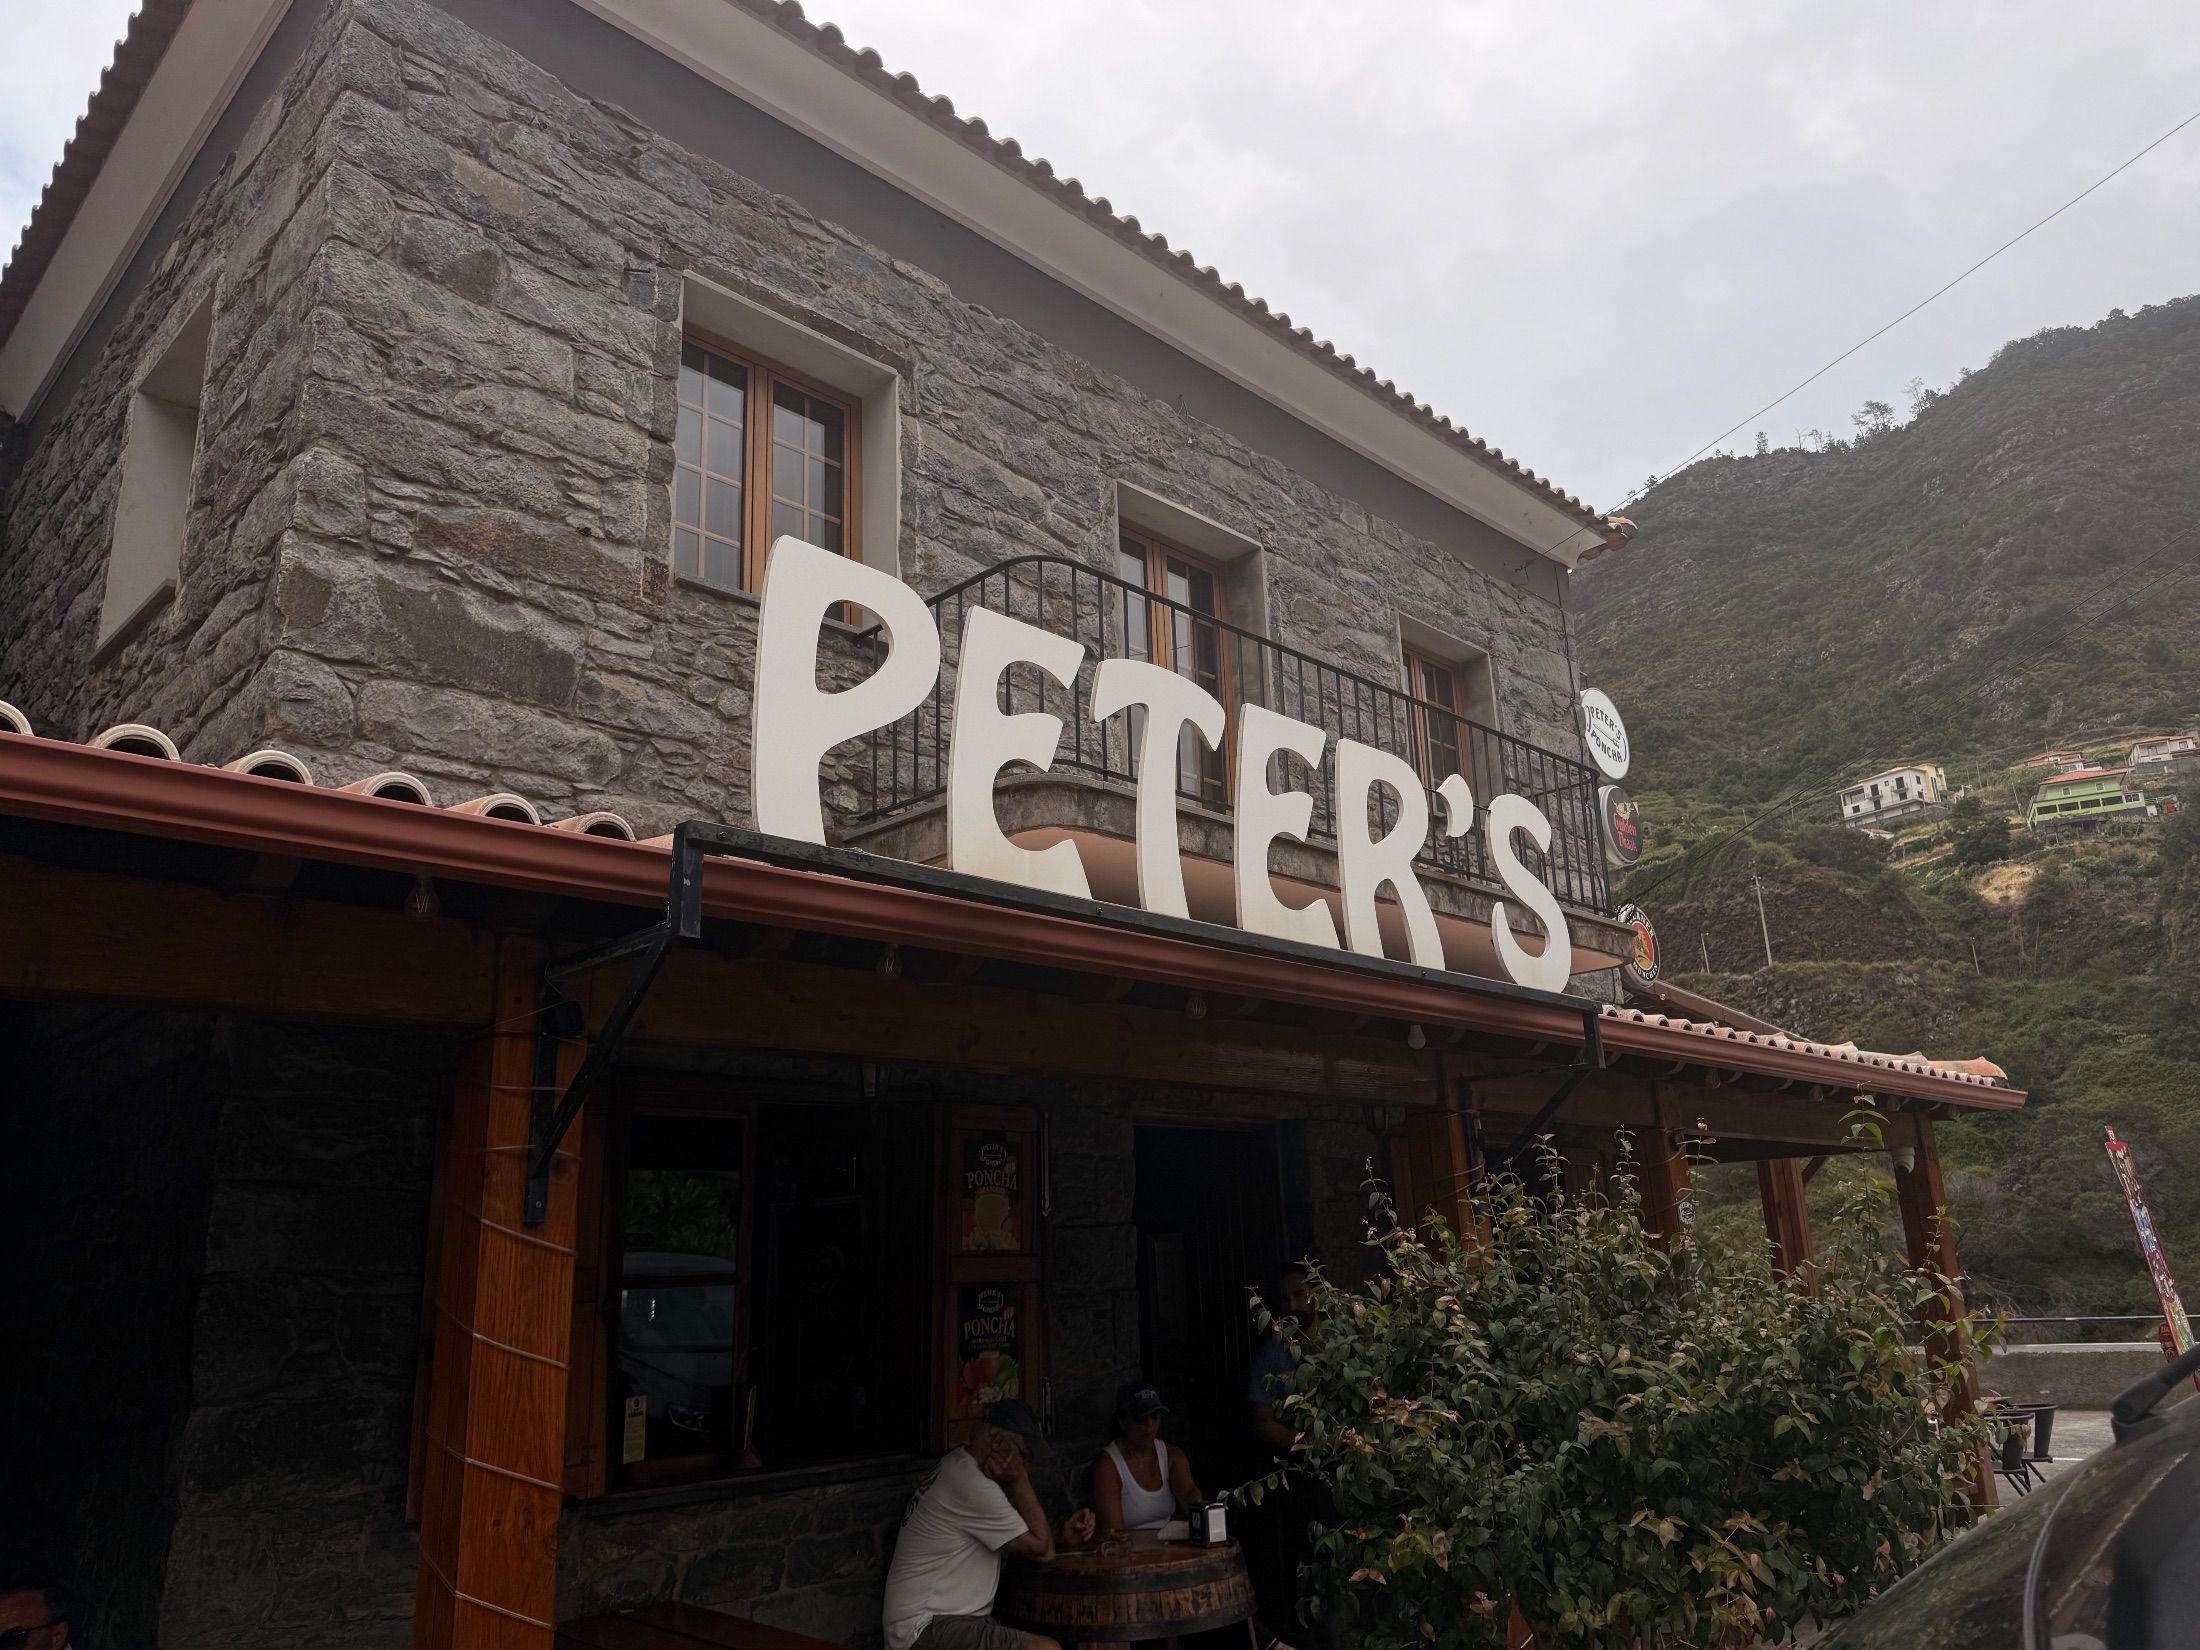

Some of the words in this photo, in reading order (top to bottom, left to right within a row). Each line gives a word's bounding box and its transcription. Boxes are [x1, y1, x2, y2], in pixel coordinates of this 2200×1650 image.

[1590, 706, 1622, 740] PETER'S
[1591, 730, 1623, 763] PONCHA
[752, 534, 1572, 995] PETER'S
[965, 1169, 1017, 1190] PONCHA
[963, 1316, 1016, 1340] PONCHA
